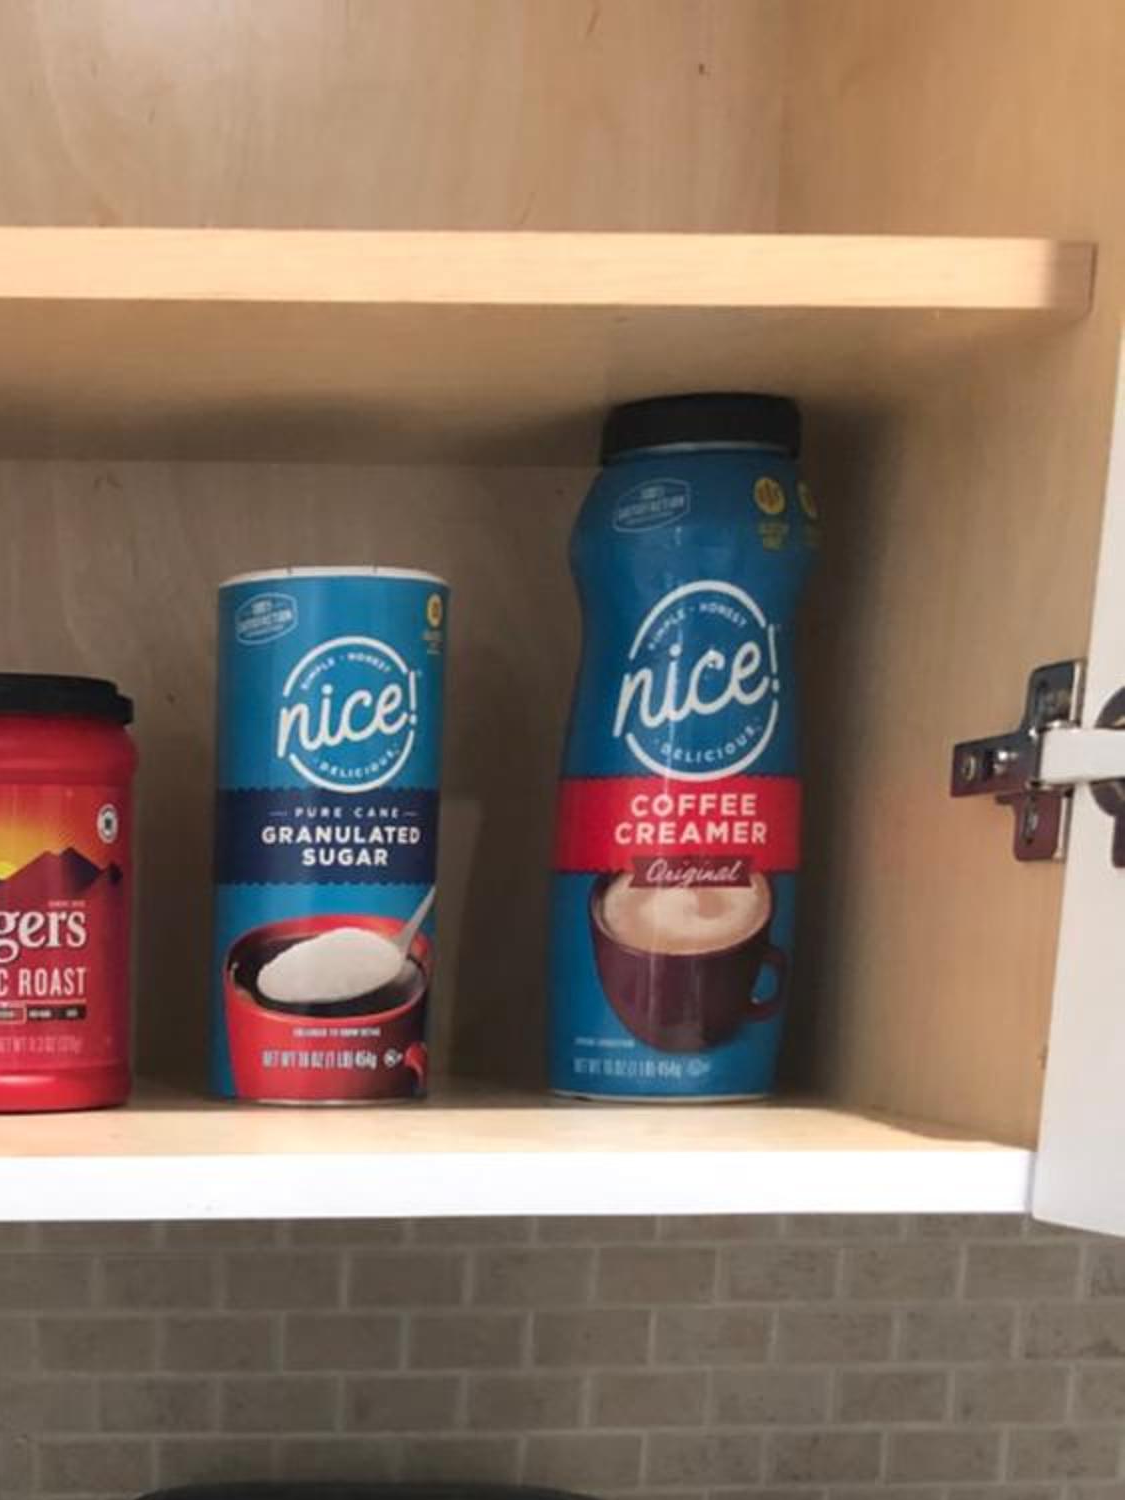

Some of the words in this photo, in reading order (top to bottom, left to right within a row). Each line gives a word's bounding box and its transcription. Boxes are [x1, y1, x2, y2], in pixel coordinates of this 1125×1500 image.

[699, 602, 748, 627] HONEST
[301, 658, 335, 690] SIMPLE
[347, 652, 391, 673] HONEST
[612, 623, 779, 737] nice!
[277, 670, 417, 758] nice!
[660, 722, 756, 764] DELICIOUS
[294, 807, 342, 818] PURE
[354, 807, 400, 818] CANE
[630, 793, 758, 816] COFFEE
[261, 826, 421, 845] GRANULATED
[614, 821, 768, 845] CREAMER
[302, 848, 389, 866] SUGAR
[645, 858, 741, 884] Original
[18, 967, 87, 997] ROAST
